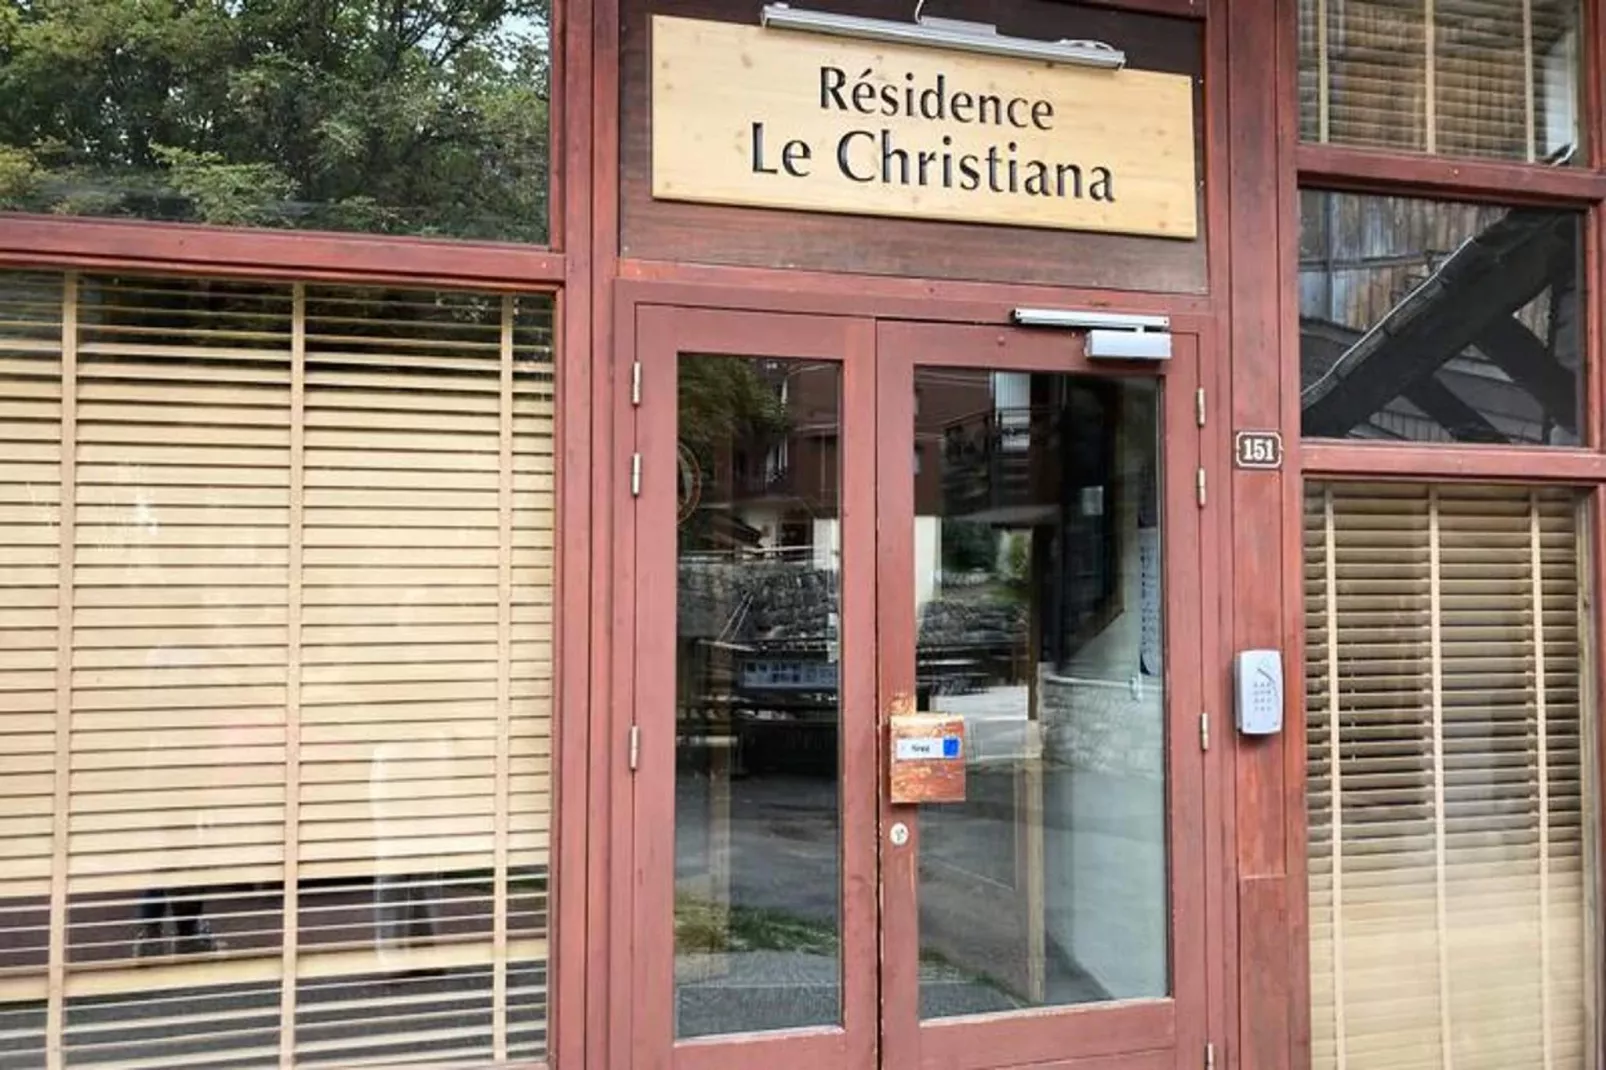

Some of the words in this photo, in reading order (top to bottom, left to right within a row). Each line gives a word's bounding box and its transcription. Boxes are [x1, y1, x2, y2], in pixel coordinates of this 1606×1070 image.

[820, 66, 1054, 130] Résidence
[752, 122, 811, 177] Le
[837, 129, 1115, 202] Christiana
[1243, 438, 1274, 460] 151
